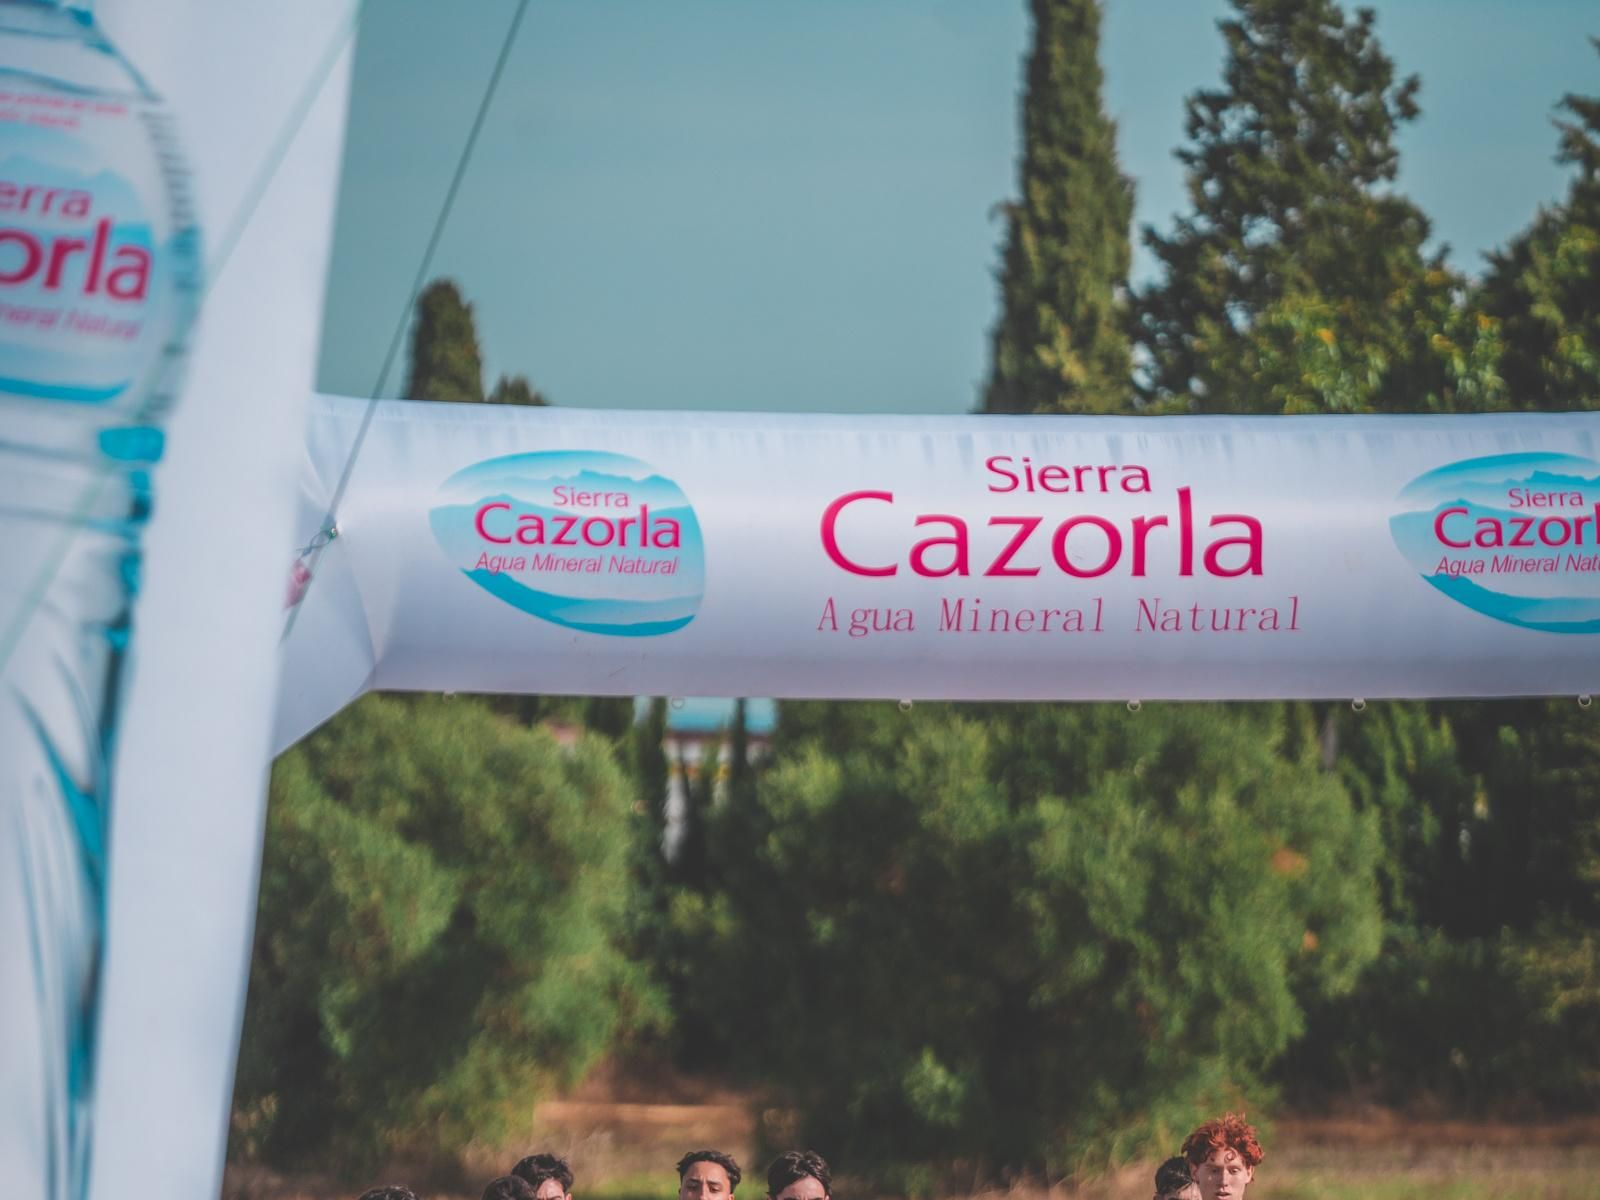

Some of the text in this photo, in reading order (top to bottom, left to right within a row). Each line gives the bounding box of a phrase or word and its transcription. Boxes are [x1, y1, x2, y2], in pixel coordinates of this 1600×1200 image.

[985, 455, 1152, 493] Sierra
[552, 485, 629, 507] Sierra
[1507, 488, 1583, 508] Sierra
[474, 503, 680, 548] Cazorla
[820, 486, 1265, 578] Cazorla
[475, 552, 678, 575] Agua Mineral Natural
[1435, 555, 1485, 580] Agua
[1491, 553, 1560, 573] Mineral
[817, 596, 1301, 638] Agua Mineral Natural
